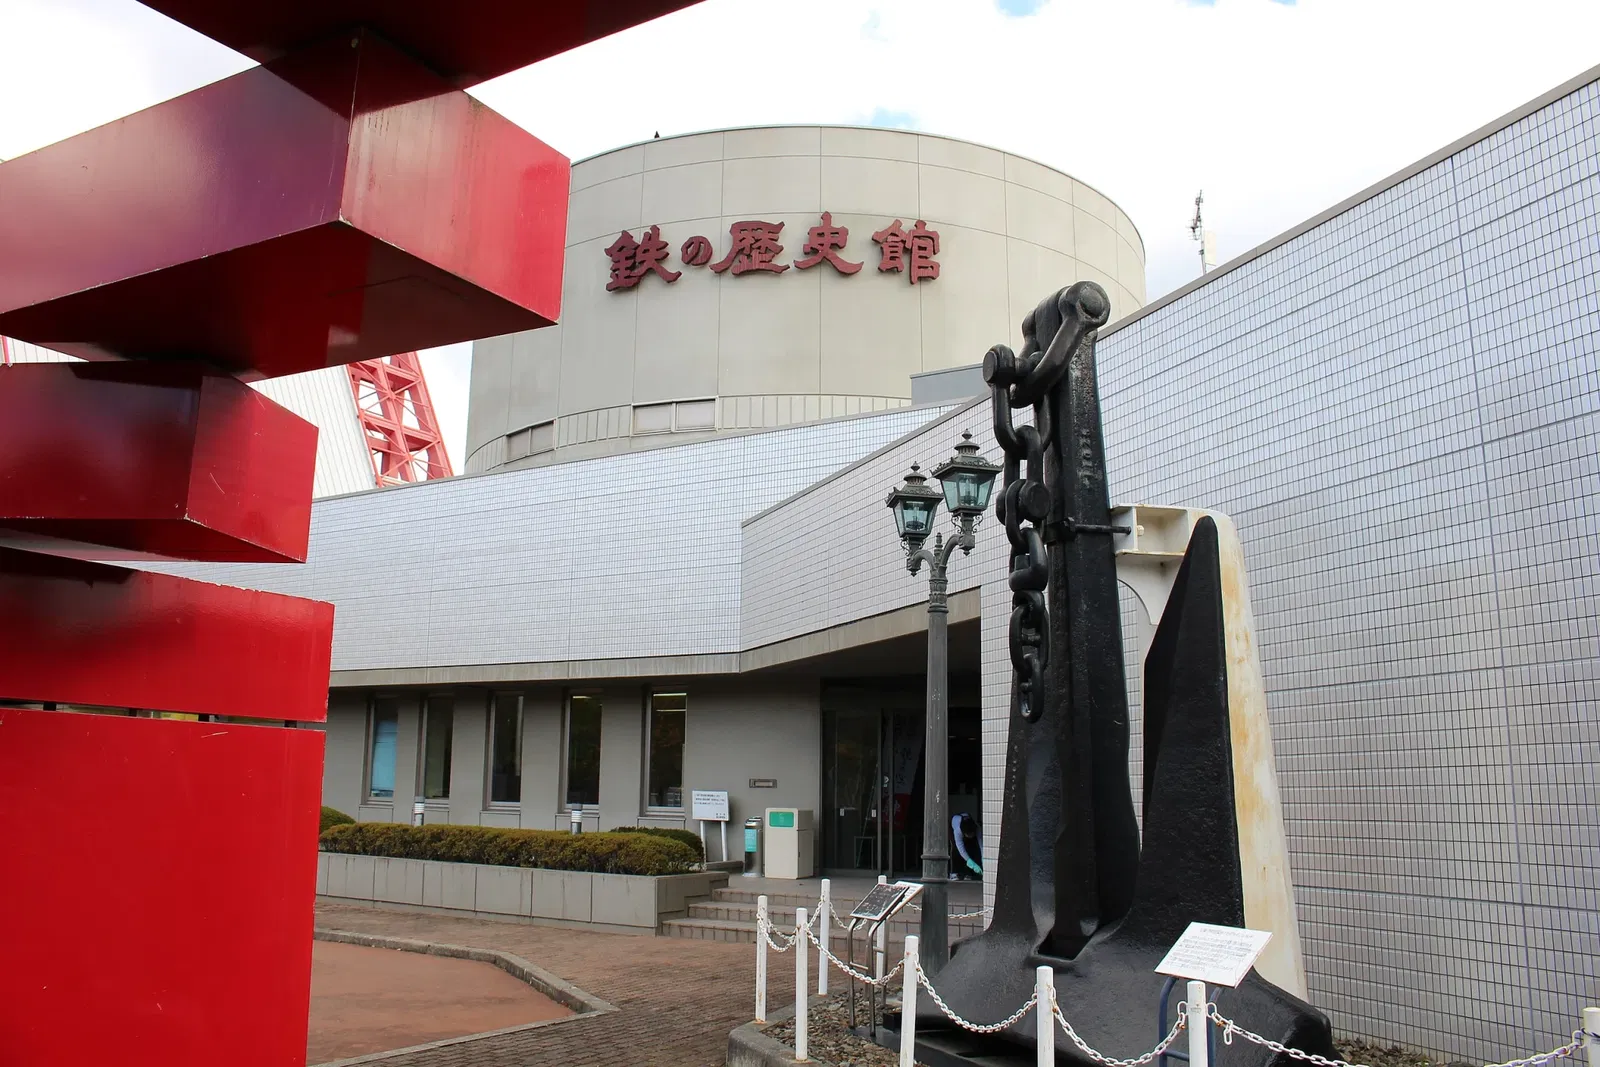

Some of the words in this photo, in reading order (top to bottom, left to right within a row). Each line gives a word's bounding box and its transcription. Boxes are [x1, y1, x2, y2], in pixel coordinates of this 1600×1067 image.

[604, 211, 940, 292] 鉄の歴史館
